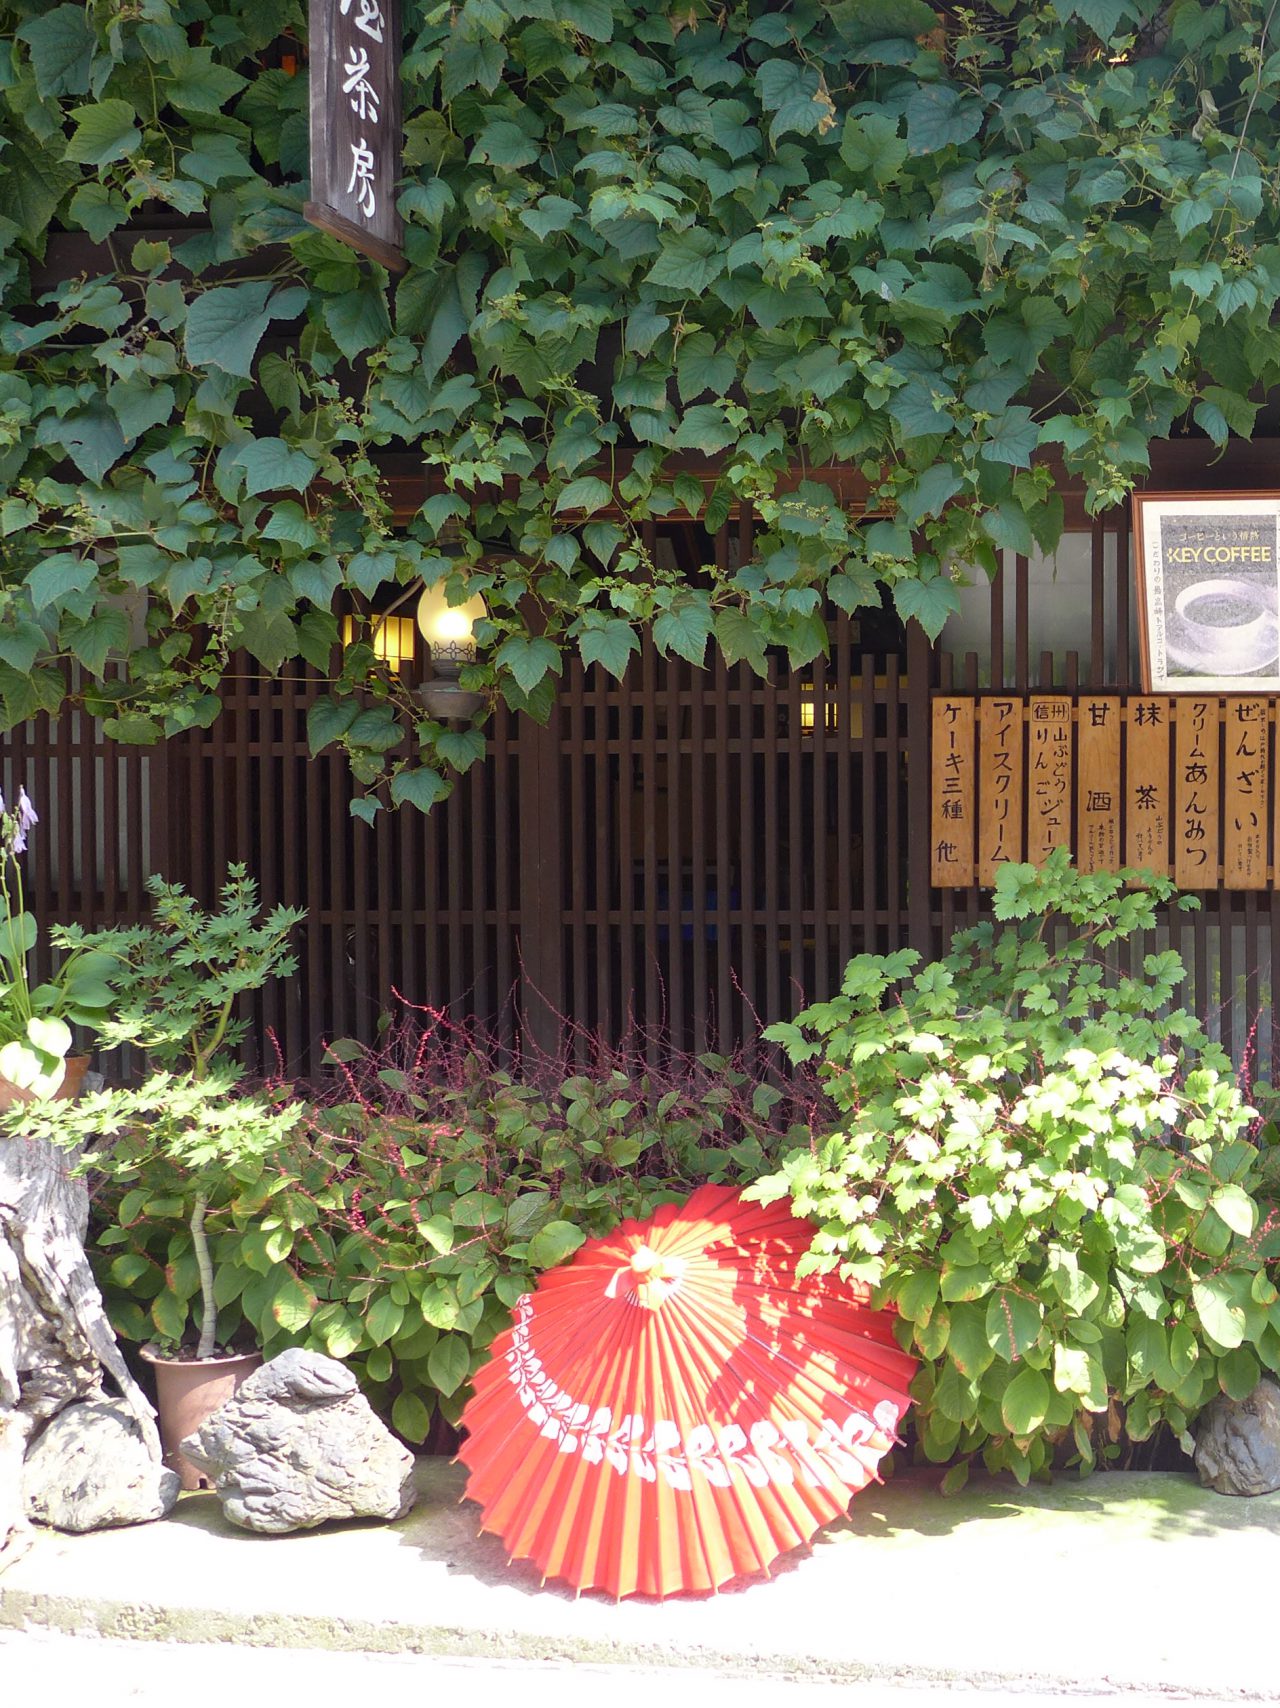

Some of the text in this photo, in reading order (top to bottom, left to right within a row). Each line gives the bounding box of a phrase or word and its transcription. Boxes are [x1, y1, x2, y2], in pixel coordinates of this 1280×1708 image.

[1167, 545, 1272, 563] KEY COFFEE
[1033, 704, 1068, 721] 信州
[1086, 702, 1112, 812] 甘酒
[1134, 702, 1164, 811] 抹茶
[990, 701, 1014, 863] アイスクリーム
[1034, 727, 1051, 796] りんご
[1053, 726, 1069, 795] 山ぶどう
[1184, 702, 1208, 866] クリームあんみつ
[1235, 702, 1260, 831] ぜんざい
[1039, 798, 1064, 864] ジュース
